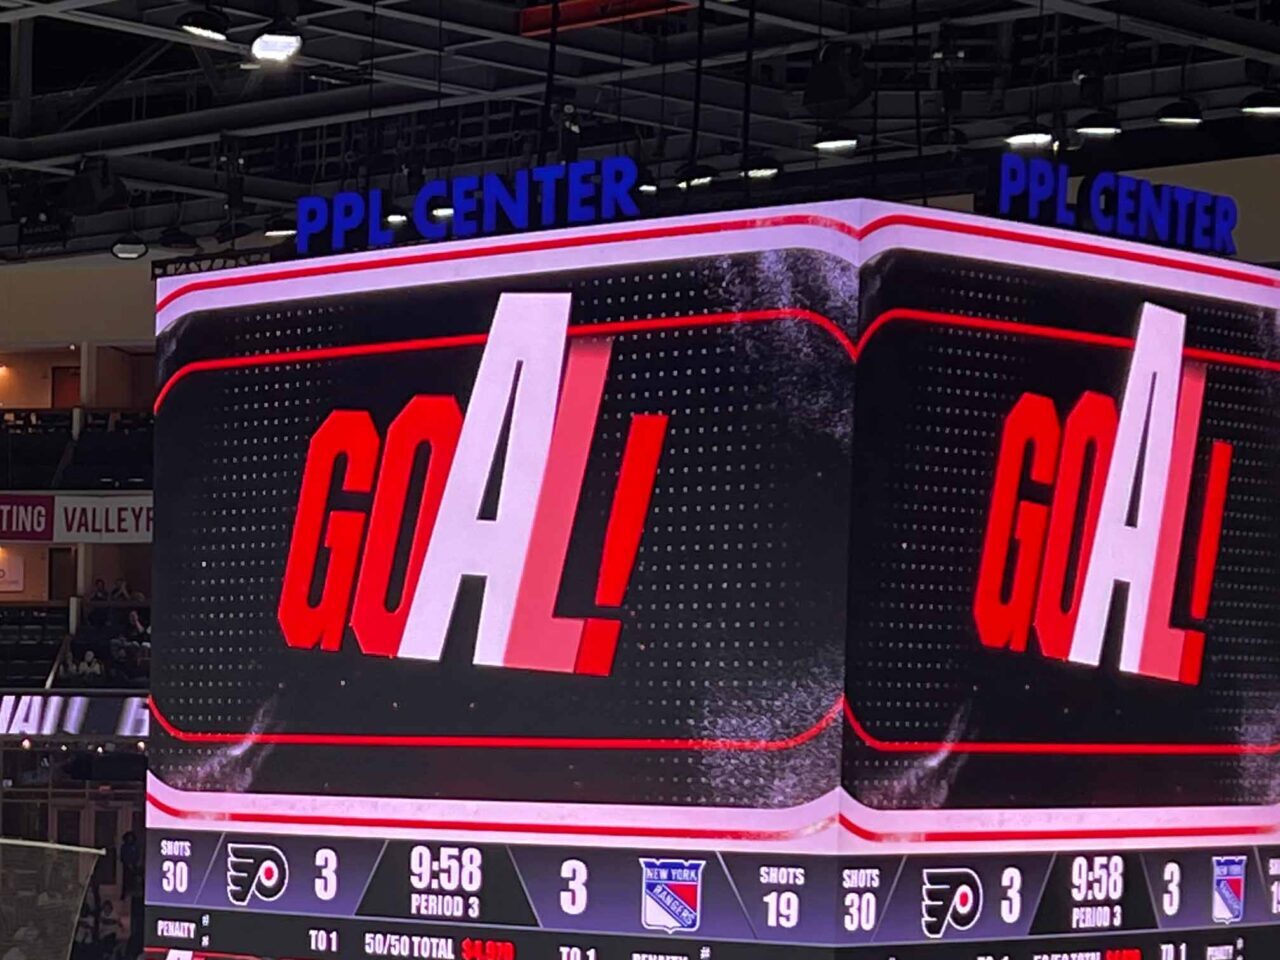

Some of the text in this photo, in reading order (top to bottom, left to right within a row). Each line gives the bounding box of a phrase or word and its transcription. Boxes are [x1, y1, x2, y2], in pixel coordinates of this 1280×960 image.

[296, 155, 640, 254] PPL CENTER
[999, 152, 1238, 255] PPL CENTER
[277, 291, 668, 677] GOAL!
[972, 301, 1233, 686] GOAL!
[161, 840, 192, 857] SHOTS
[409, 845, 483, 892] 9:58
[161, 862, 189, 893] 30
[314, 848, 338, 901] 3
[559, 860, 588, 915] 3
[646, 867, 700, 883] NEW YORK
[759, 866, 805, 886] SHOTS
[841, 868, 881, 889] SHOTS
[1071, 856, 1123, 902] 9:58
[1162, 862, 1182, 916] 3
[410, 894, 481, 918] PERIOD 3
[651, 882, 698, 927] RANGERS
[762, 891, 799, 928] 19
[844, 892, 876, 932] 30
[1000, 866, 1021, 924] 3
[156, 920, 196, 940] PENALTY
[1071, 906, 1122, 930] PERIOD 3
[364, 933, 410, 957] 50/50
[411, 936, 455, 960] TOTAL
[700, 947, 711, 960] #
